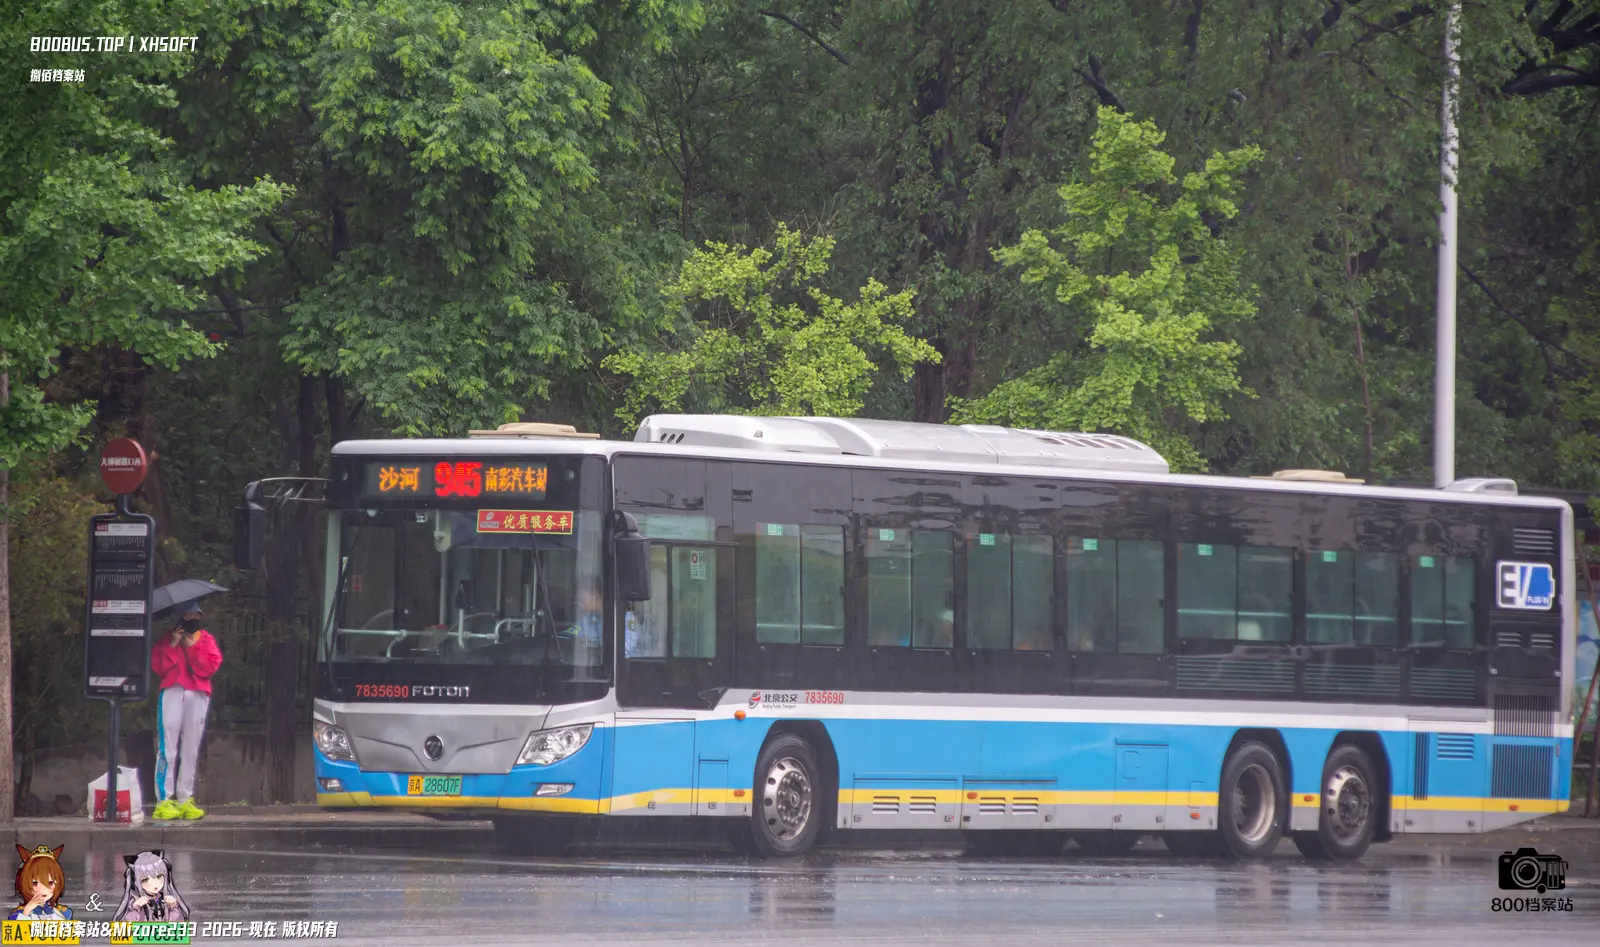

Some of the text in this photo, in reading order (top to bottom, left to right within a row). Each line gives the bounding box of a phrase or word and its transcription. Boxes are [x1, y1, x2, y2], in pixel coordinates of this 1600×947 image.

[379, 466, 420, 491] 沙河
[434, 461, 482, 497] 945
[503, 513, 569, 531] 优质服务车
[355, 684, 470, 698] 7835690 FOTON
[763, 693, 798, 703] 北京公交
[804, 691, 844, 705] 7835690
